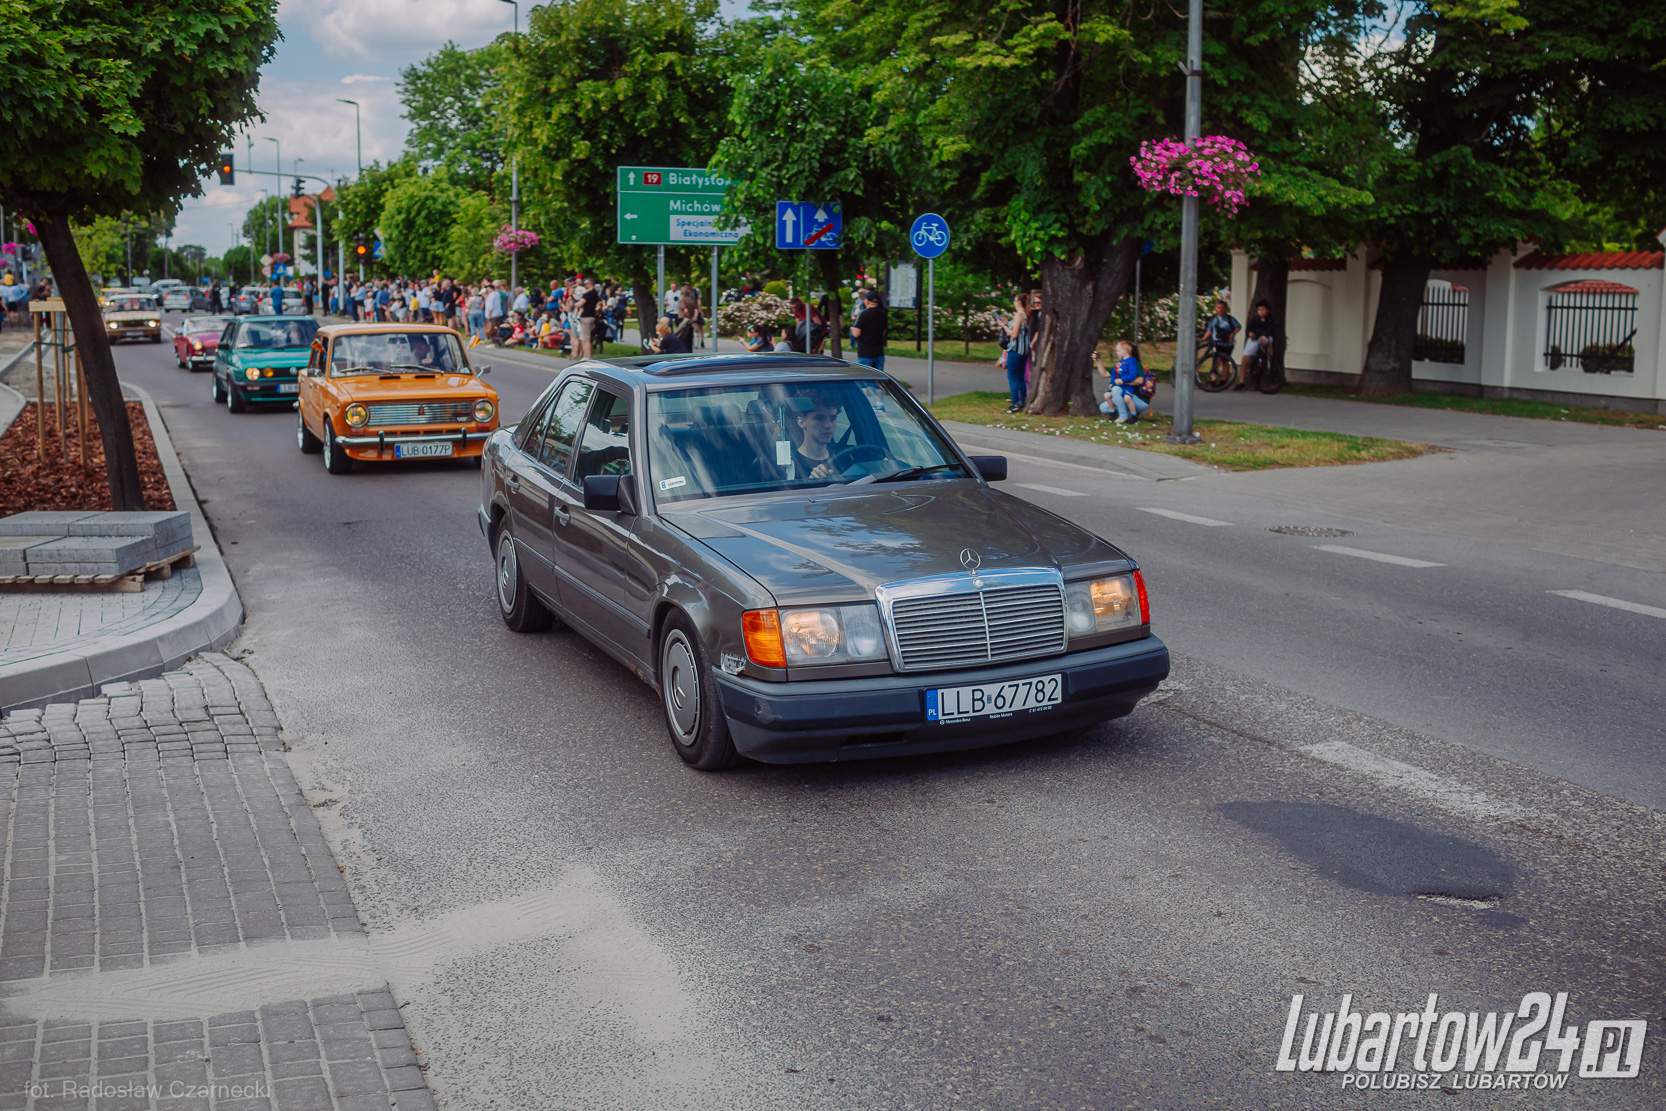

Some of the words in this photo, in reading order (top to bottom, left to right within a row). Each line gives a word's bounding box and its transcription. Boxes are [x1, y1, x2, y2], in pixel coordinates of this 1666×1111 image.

[647, 174, 658, 183] 19
[401, 446, 420, 456] LUB
[421, 444, 451, 455] 0177P
[940, 688, 986, 717] LLB
[993, 677, 1059, 710] 67782
